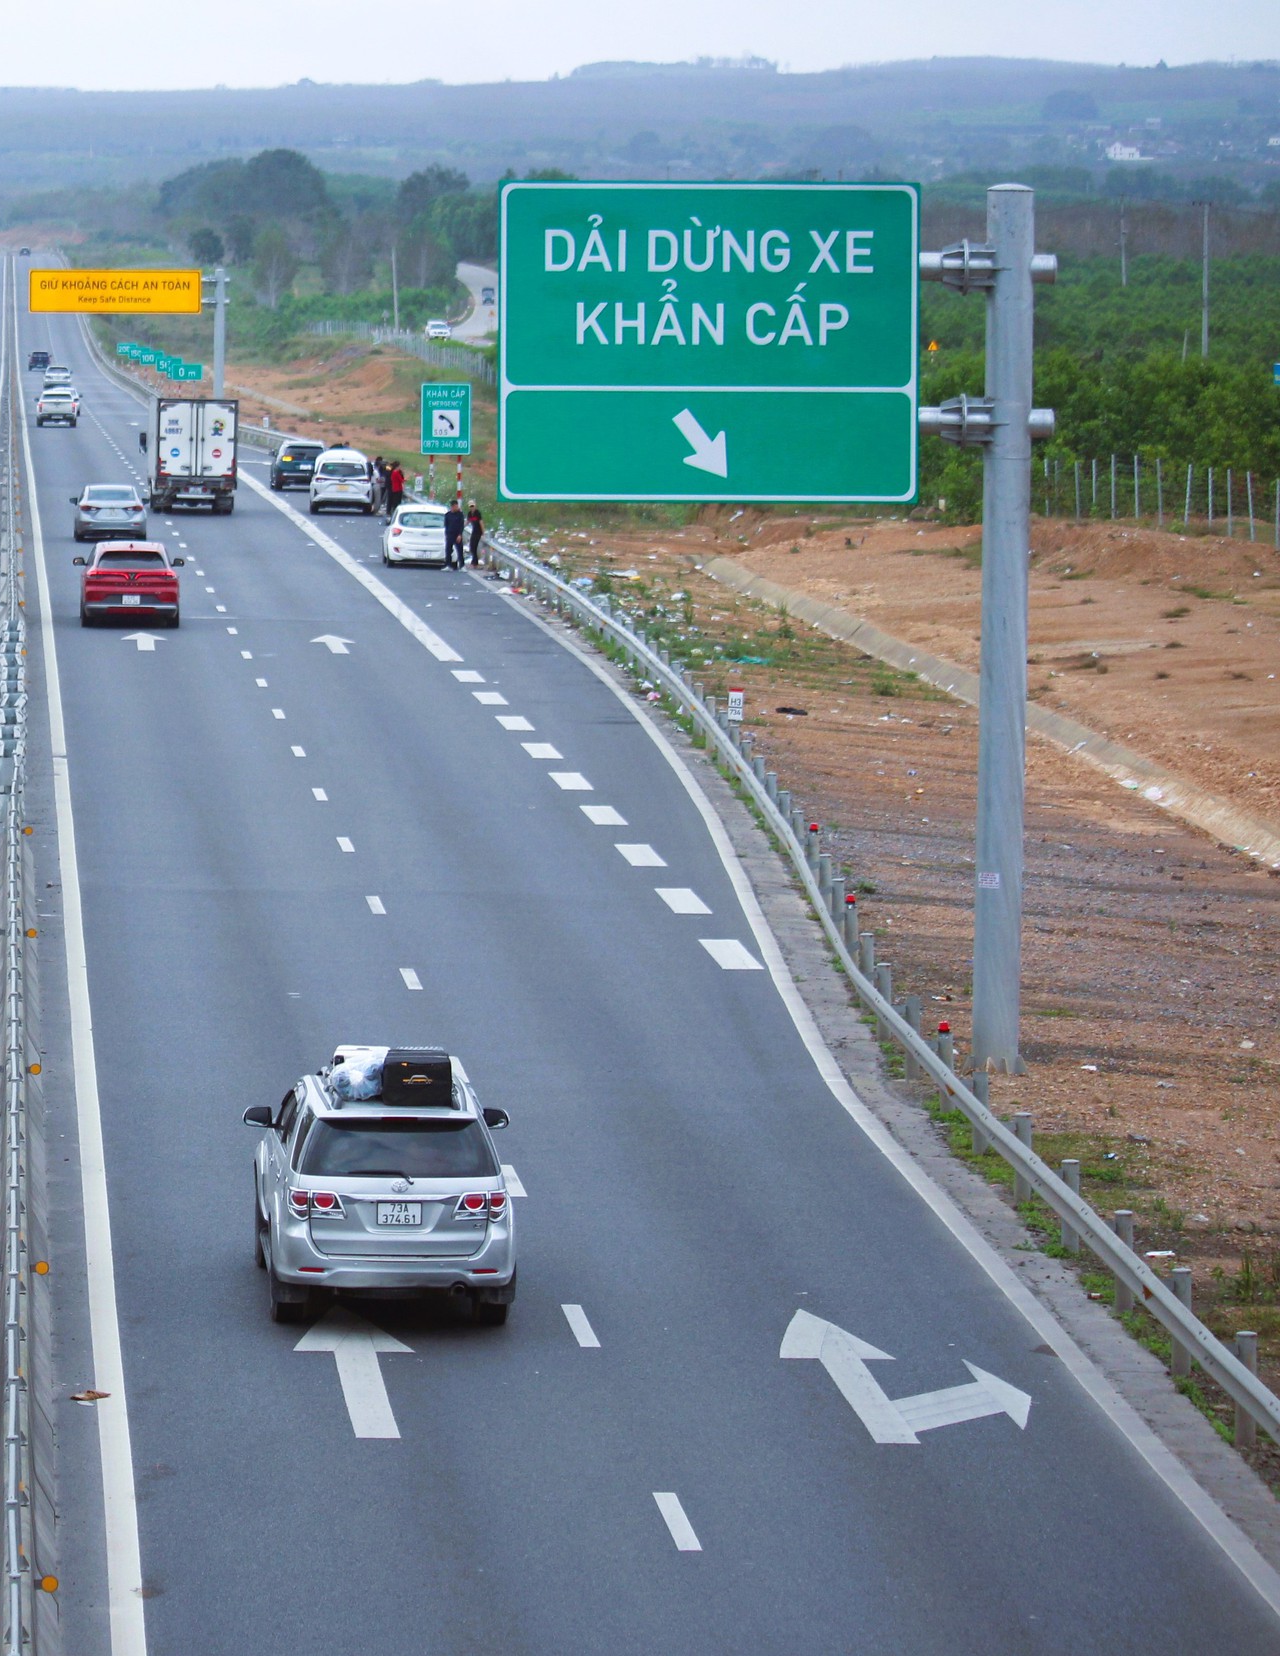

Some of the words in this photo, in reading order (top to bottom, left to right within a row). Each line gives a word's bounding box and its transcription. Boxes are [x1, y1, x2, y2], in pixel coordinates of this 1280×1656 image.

[544, 213, 627, 273] DẢI
[647, 216, 792, 274] DỪNG
[807, 230, 875, 275] XE
[61, 276, 107, 290] KHOẢNG
[110, 278, 139, 290] CÁCH
[142, 280, 158, 290] AN
[161, 278, 190, 290] TOÀN
[78, 295, 98, 305] Keep
[99, 295, 117, 304] Safe
[118, 295, 151, 304] Distance
[575, 278, 725, 346] KHẨN
[745, 281, 850, 347] CẤP
[141, 354, 155, 362] 100
[178, 367, 185, 377] 0
[427, 400, 463, 408] EMERGENCY
[730, 697, 742, 706] H3
[389, 1203, 410, 1214] 73A
[382, 1214, 416, 1224] 374.61
